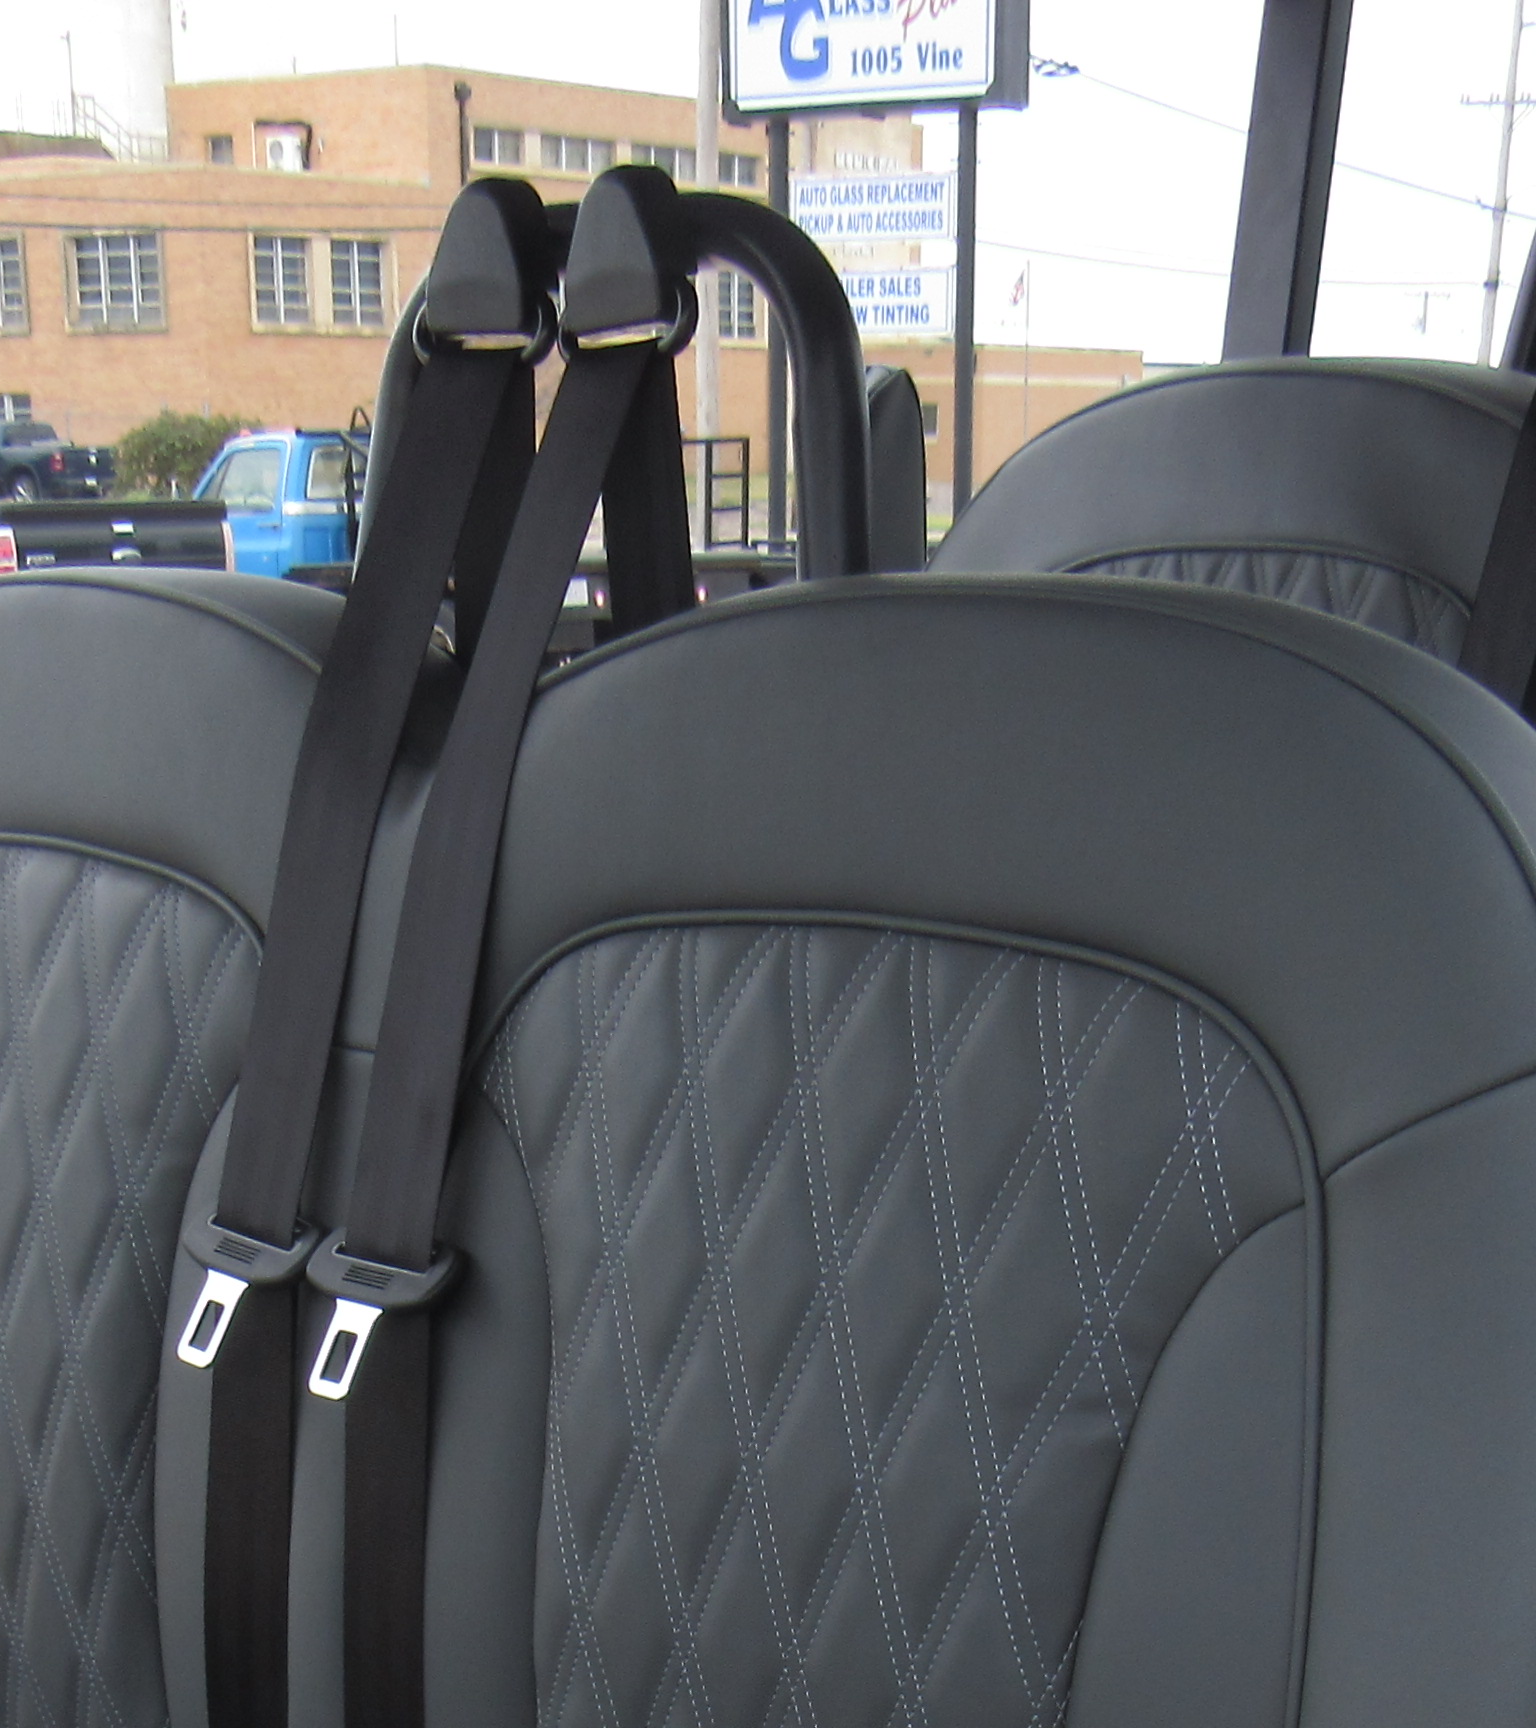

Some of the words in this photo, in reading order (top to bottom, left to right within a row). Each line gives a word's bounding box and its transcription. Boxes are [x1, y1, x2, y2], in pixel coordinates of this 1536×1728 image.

[851, 46, 902, 77] 1005
[917, 42, 963, 72] Vine
[799, 186, 827, 207] AUTO
[830, 185, 863, 206] GLASS
[867, 181, 945, 204] REPLACEMENT
[799, 214, 834, 235] PICKUP
[837, 213, 843, 233] &
[847, 211, 873, 233] AUTO
[875, 210, 943, 232] ACCESSORIES
[879, 277, 921, 298] SALES
[872, 304, 930, 326] TINTING
